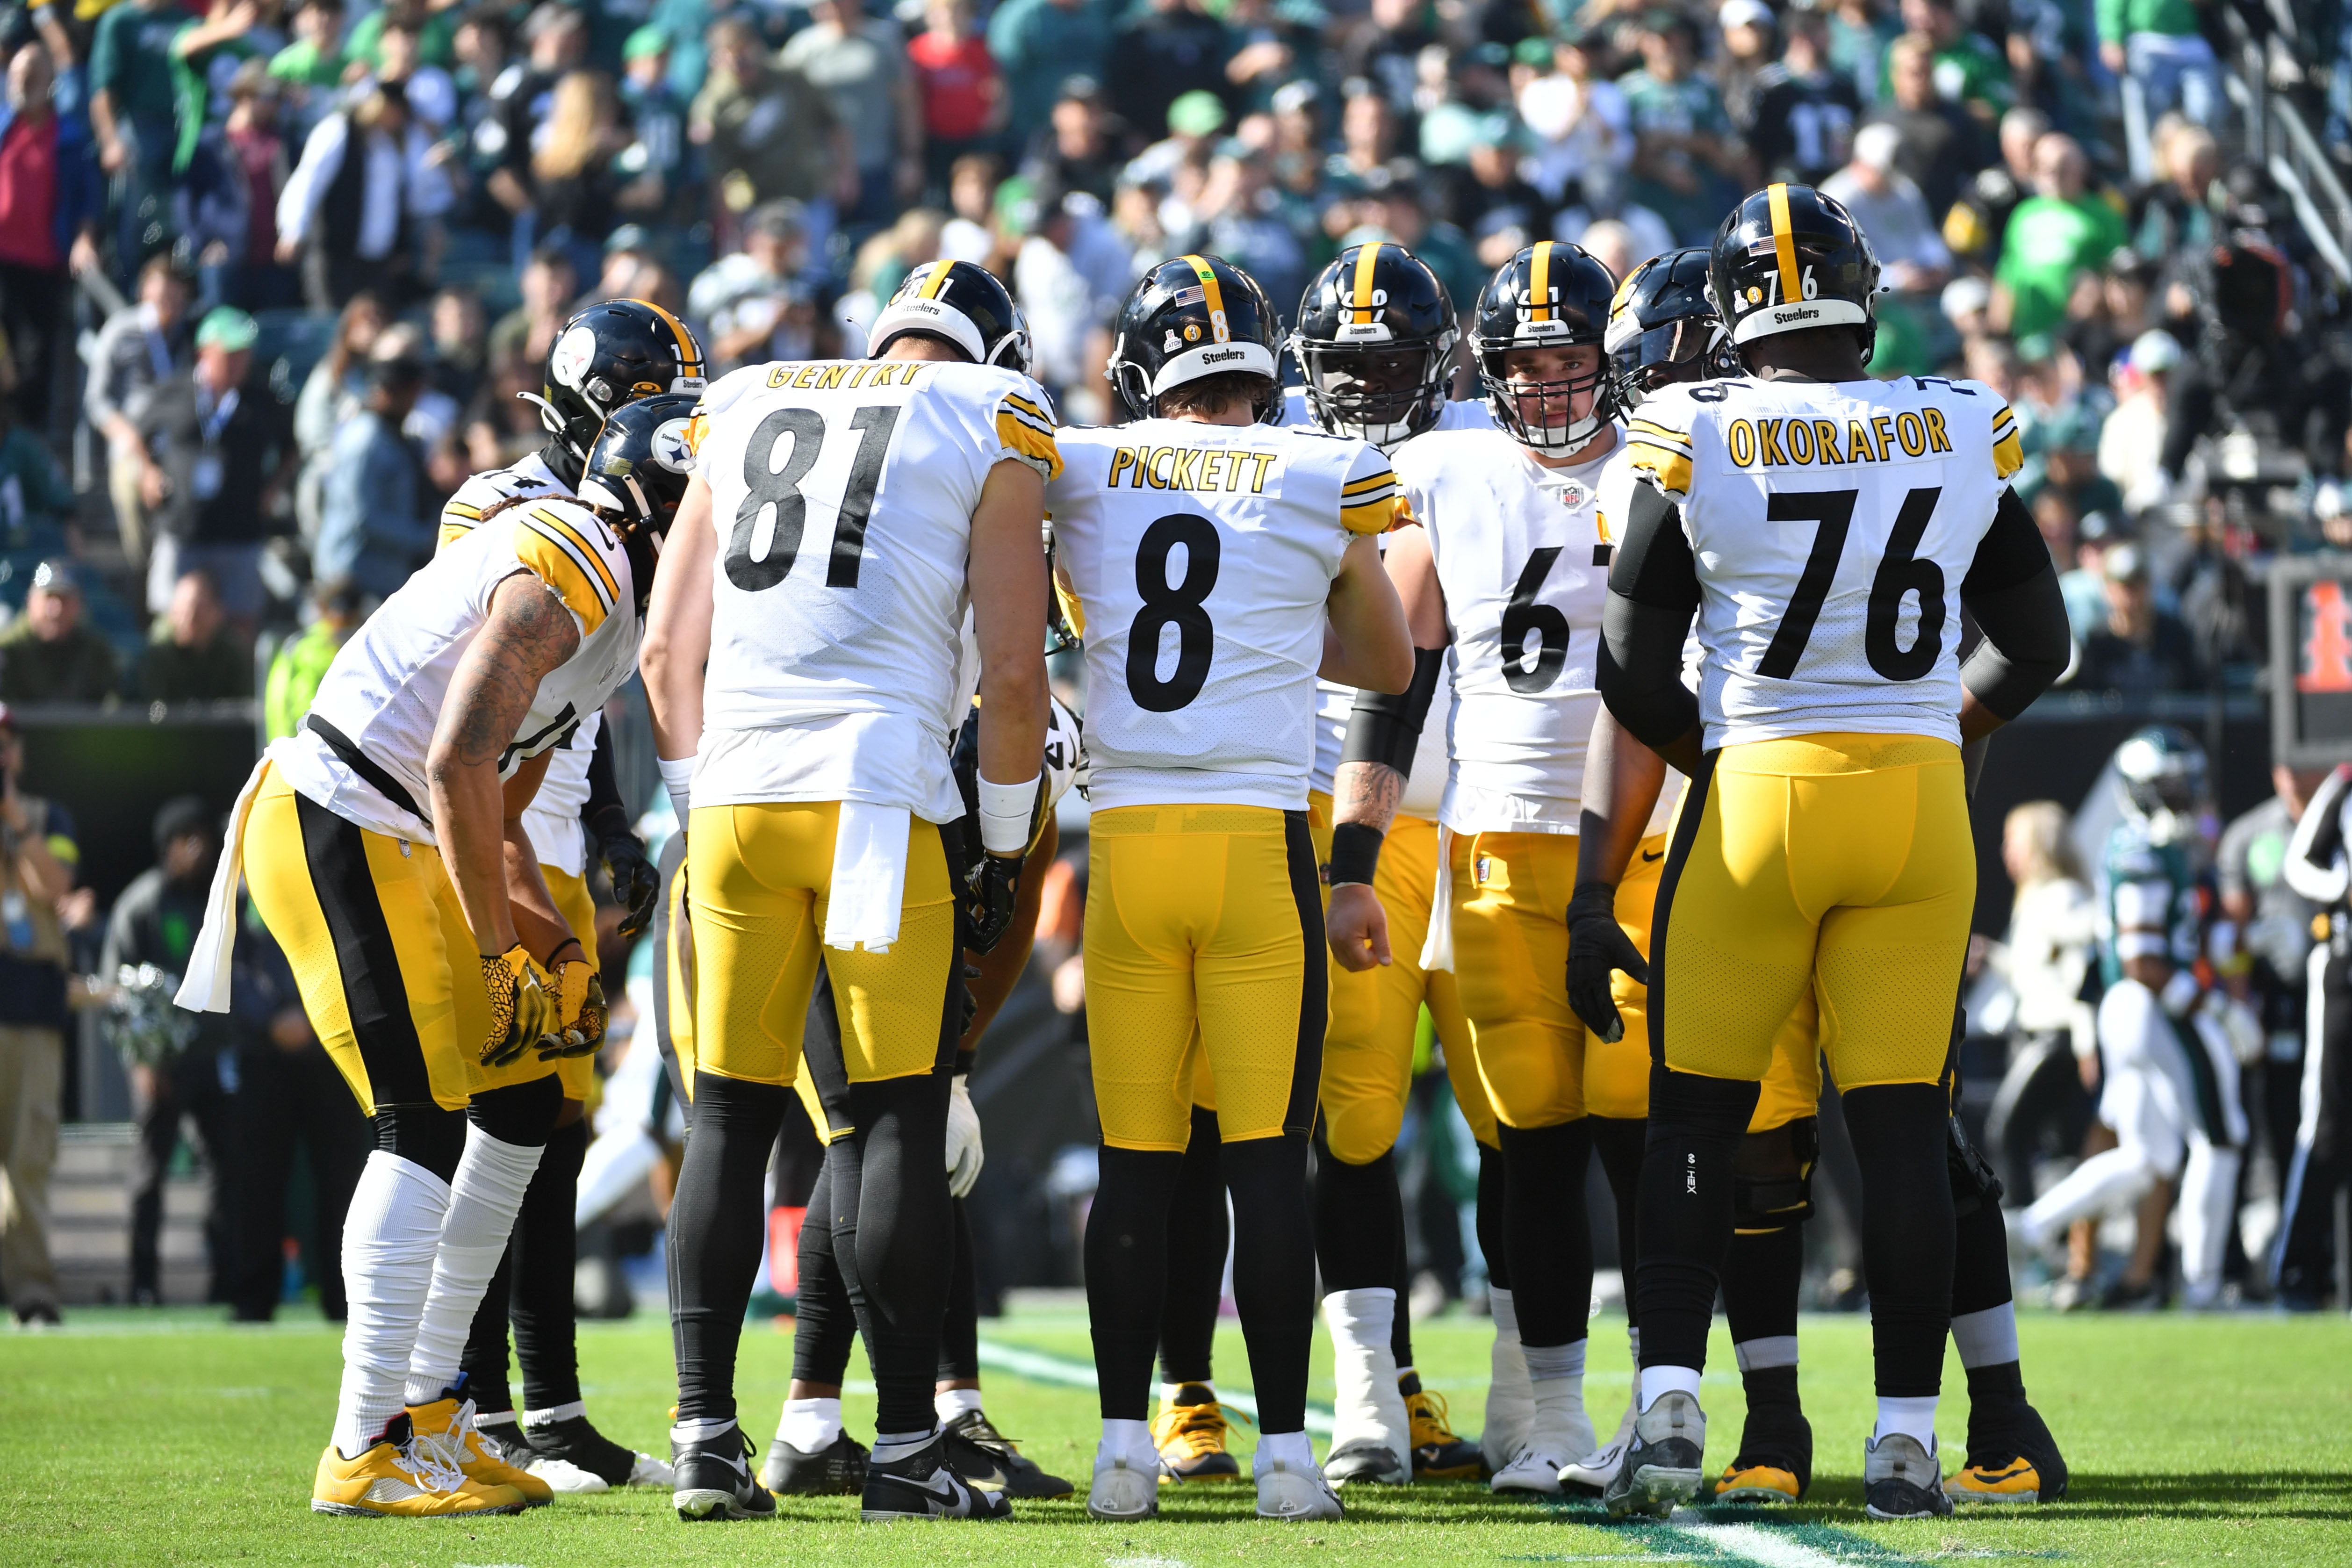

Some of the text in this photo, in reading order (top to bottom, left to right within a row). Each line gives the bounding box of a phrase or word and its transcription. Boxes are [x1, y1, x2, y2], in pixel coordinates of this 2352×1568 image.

[908, 277, 954, 302] 81
[1751, 288, 1759, 303] 3
[1764, 265, 1818, 307] 76
[1338, 289, 1388, 324] 69
[1516, 287, 1559, 323] 61
[1774, 308, 1819, 324] Steelers
[1189, 326, 1197, 341] 3
[1211, 310, 1229, 343] 8
[1528, 324, 1555, 333] Steelers
[1165, 340, 1181, 349] CATCH
[1202, 348, 1245, 365] Steelers
[766, 363, 931, 389] GENTRY
[661, 433, 681, 444] Steelers
[1729, 407, 1953, 468] OKORAFOR
[1108, 446, 1277, 494] PICKETT
[724, 405, 901, 592] 81
[1754, 485, 1947, 682] 76
[1126, 513, 1221, 712] 8
[1687, 1170, 1697, 1195] HEX
